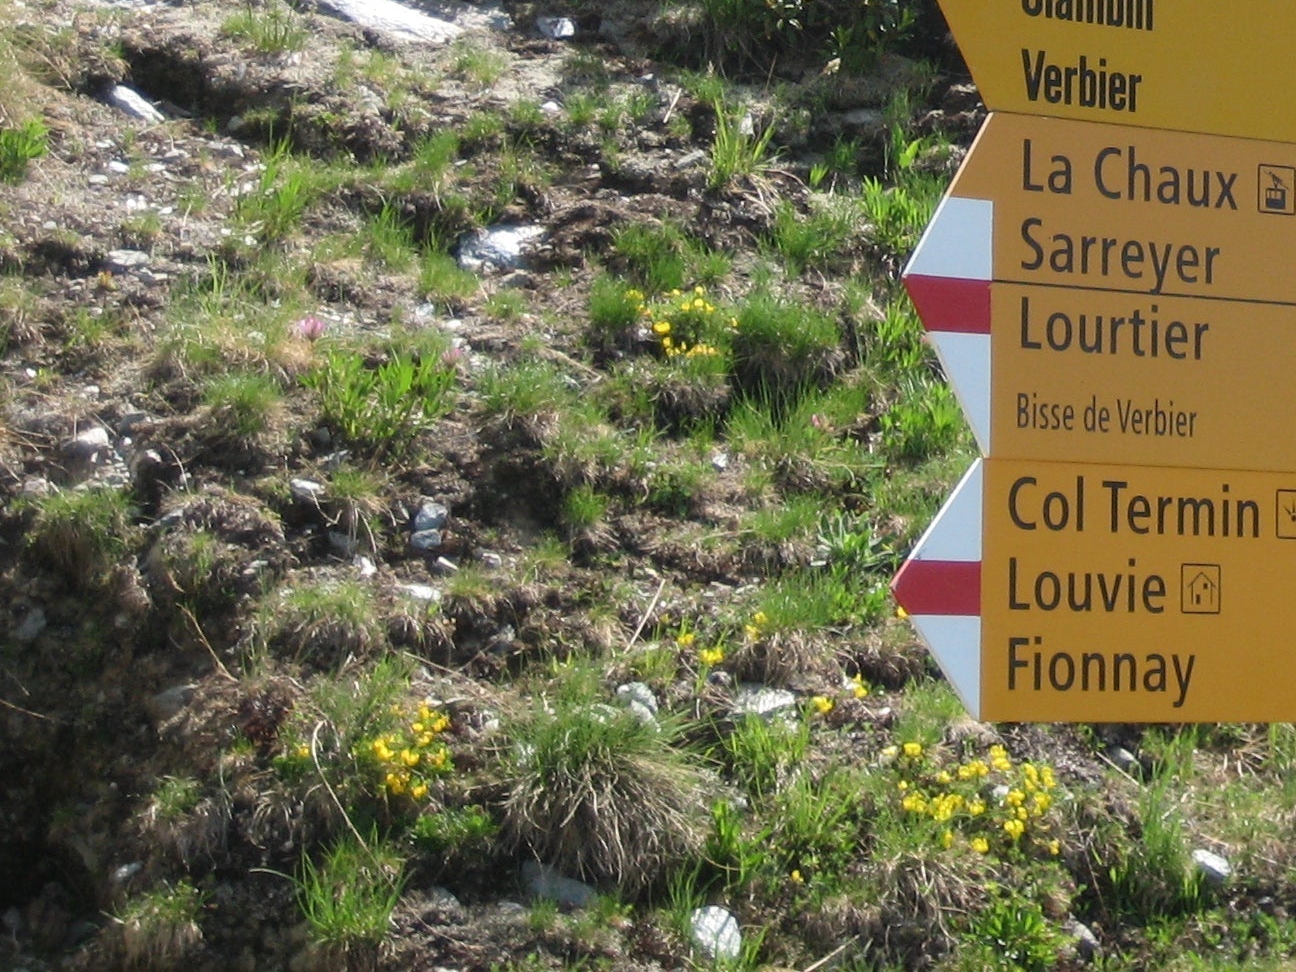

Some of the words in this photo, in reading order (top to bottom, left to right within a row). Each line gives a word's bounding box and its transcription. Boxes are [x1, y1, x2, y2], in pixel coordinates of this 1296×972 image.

[1021, 48, 1143, 112] Verbier
[1022, 138, 1073, 196] La
[1094, 146, 1239, 211] Chaux
[1020, 217, 1221, 294] Sarreyer
[1020, 296, 1210, 361] Lourtier
[1016, 392, 1075, 433] Bisse
[1083, 396, 1110, 434] de
[1117, 397, 1198, 439] Verbier
[1007, 475, 1083, 533] Col
[1102, 481, 1261, 539] Termin
[1008, 556, 1167, 615] Louvie
[1007, 636, 1196, 708] Fionnay
